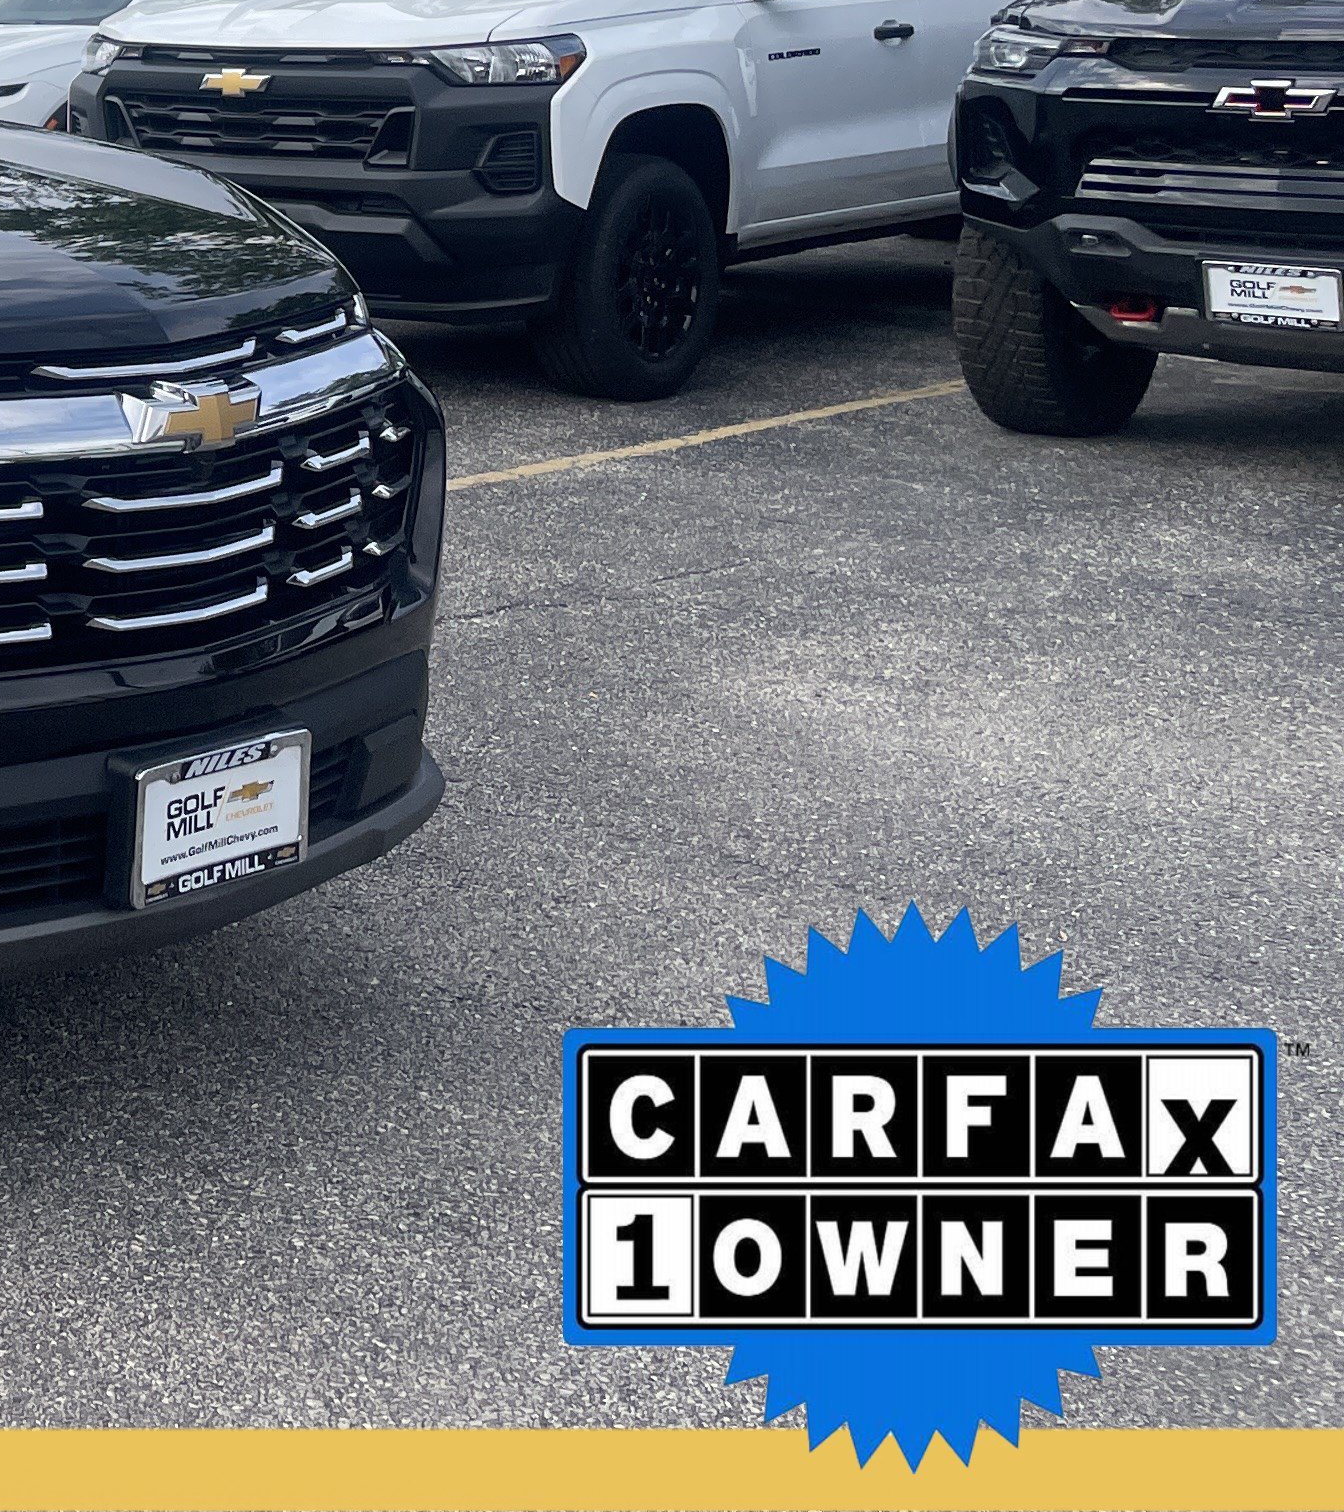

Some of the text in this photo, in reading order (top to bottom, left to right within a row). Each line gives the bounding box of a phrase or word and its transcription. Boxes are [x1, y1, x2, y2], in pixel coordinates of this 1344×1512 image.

[1229, 279, 1276, 290] GOLF
[1230, 289, 1269, 299] MILL
[1240, 314, 1311, 328] GOLF MILL
[184, 742, 267, 780] NILES
[166, 785, 226, 820] GOLF
[166, 810, 214, 842] MILL
[178, 854, 265, 893] GOLF MILL
